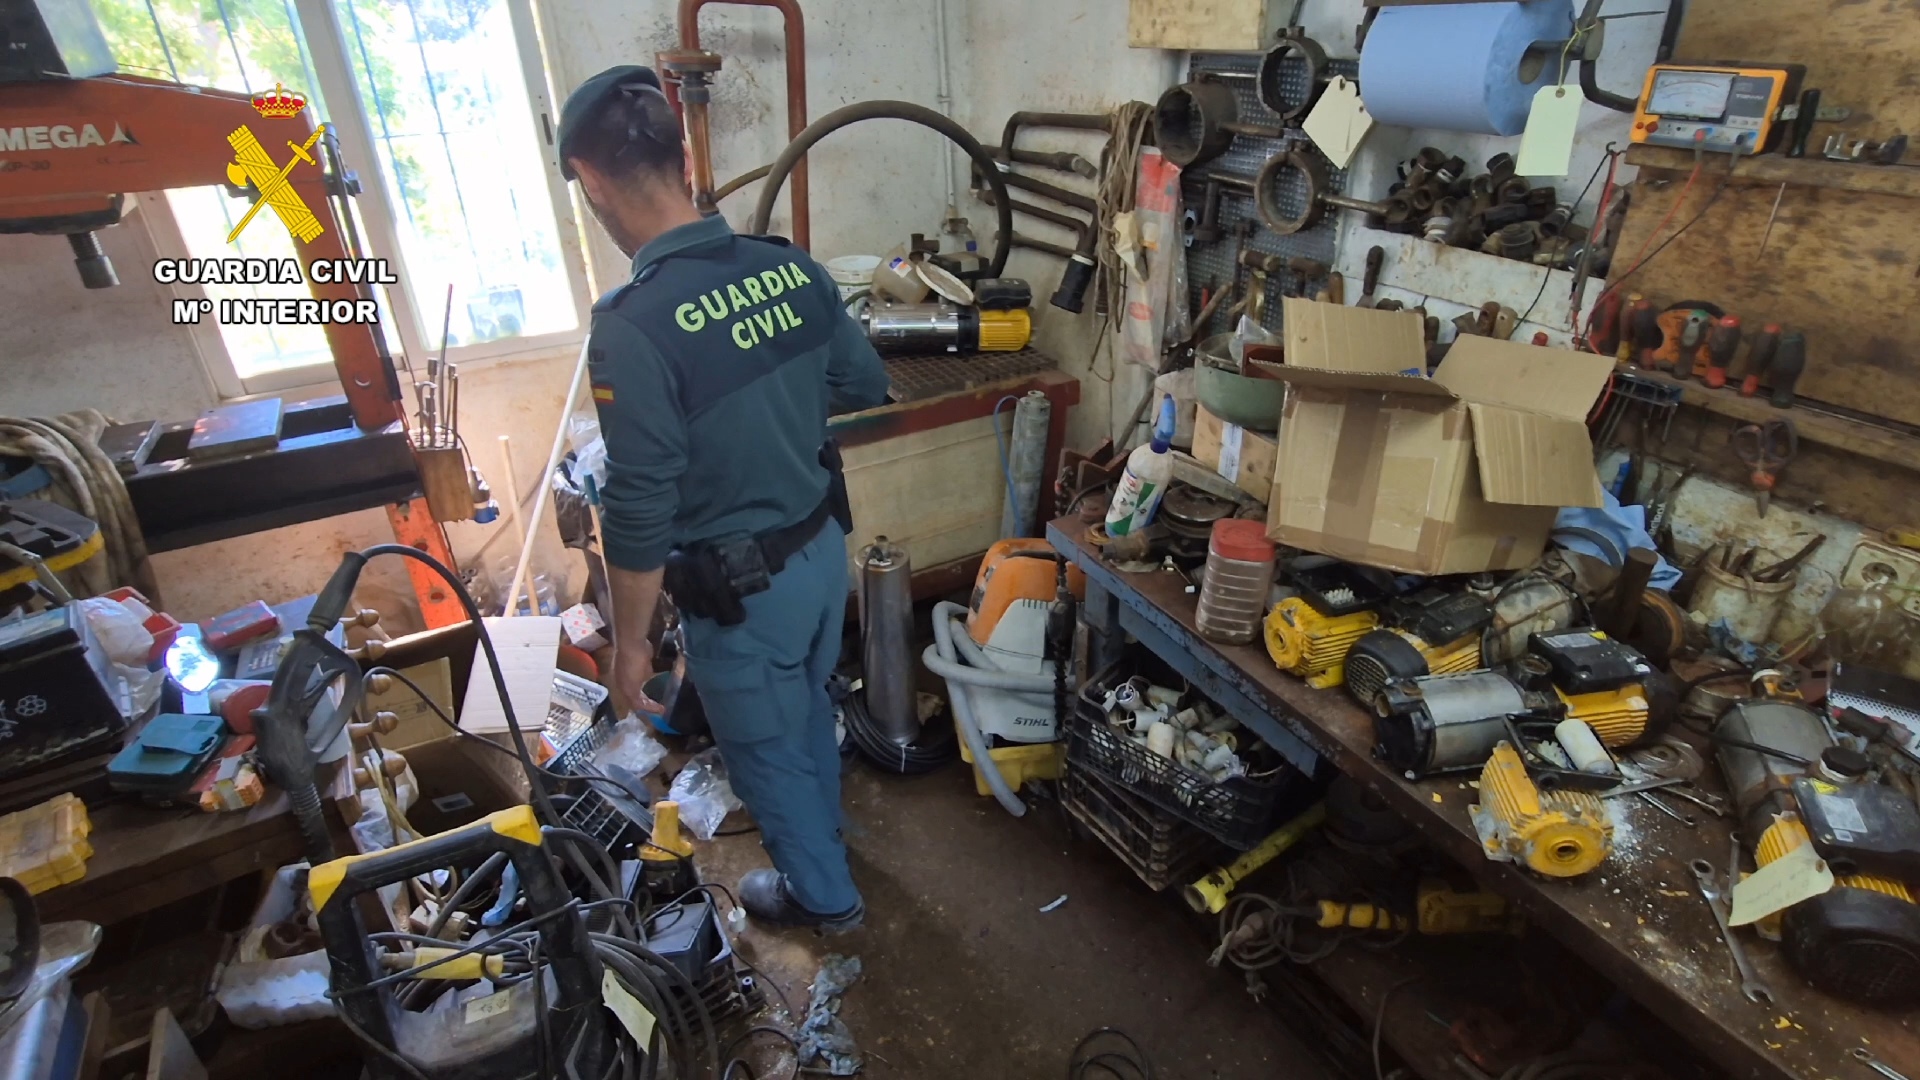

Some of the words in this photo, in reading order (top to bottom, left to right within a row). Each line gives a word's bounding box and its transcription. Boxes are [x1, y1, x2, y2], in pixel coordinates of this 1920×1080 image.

[675, 262, 811, 332] GUARDIA
[731, 302, 803, 349] CIVIL
[1013, 716, 1049, 727] STIHL
